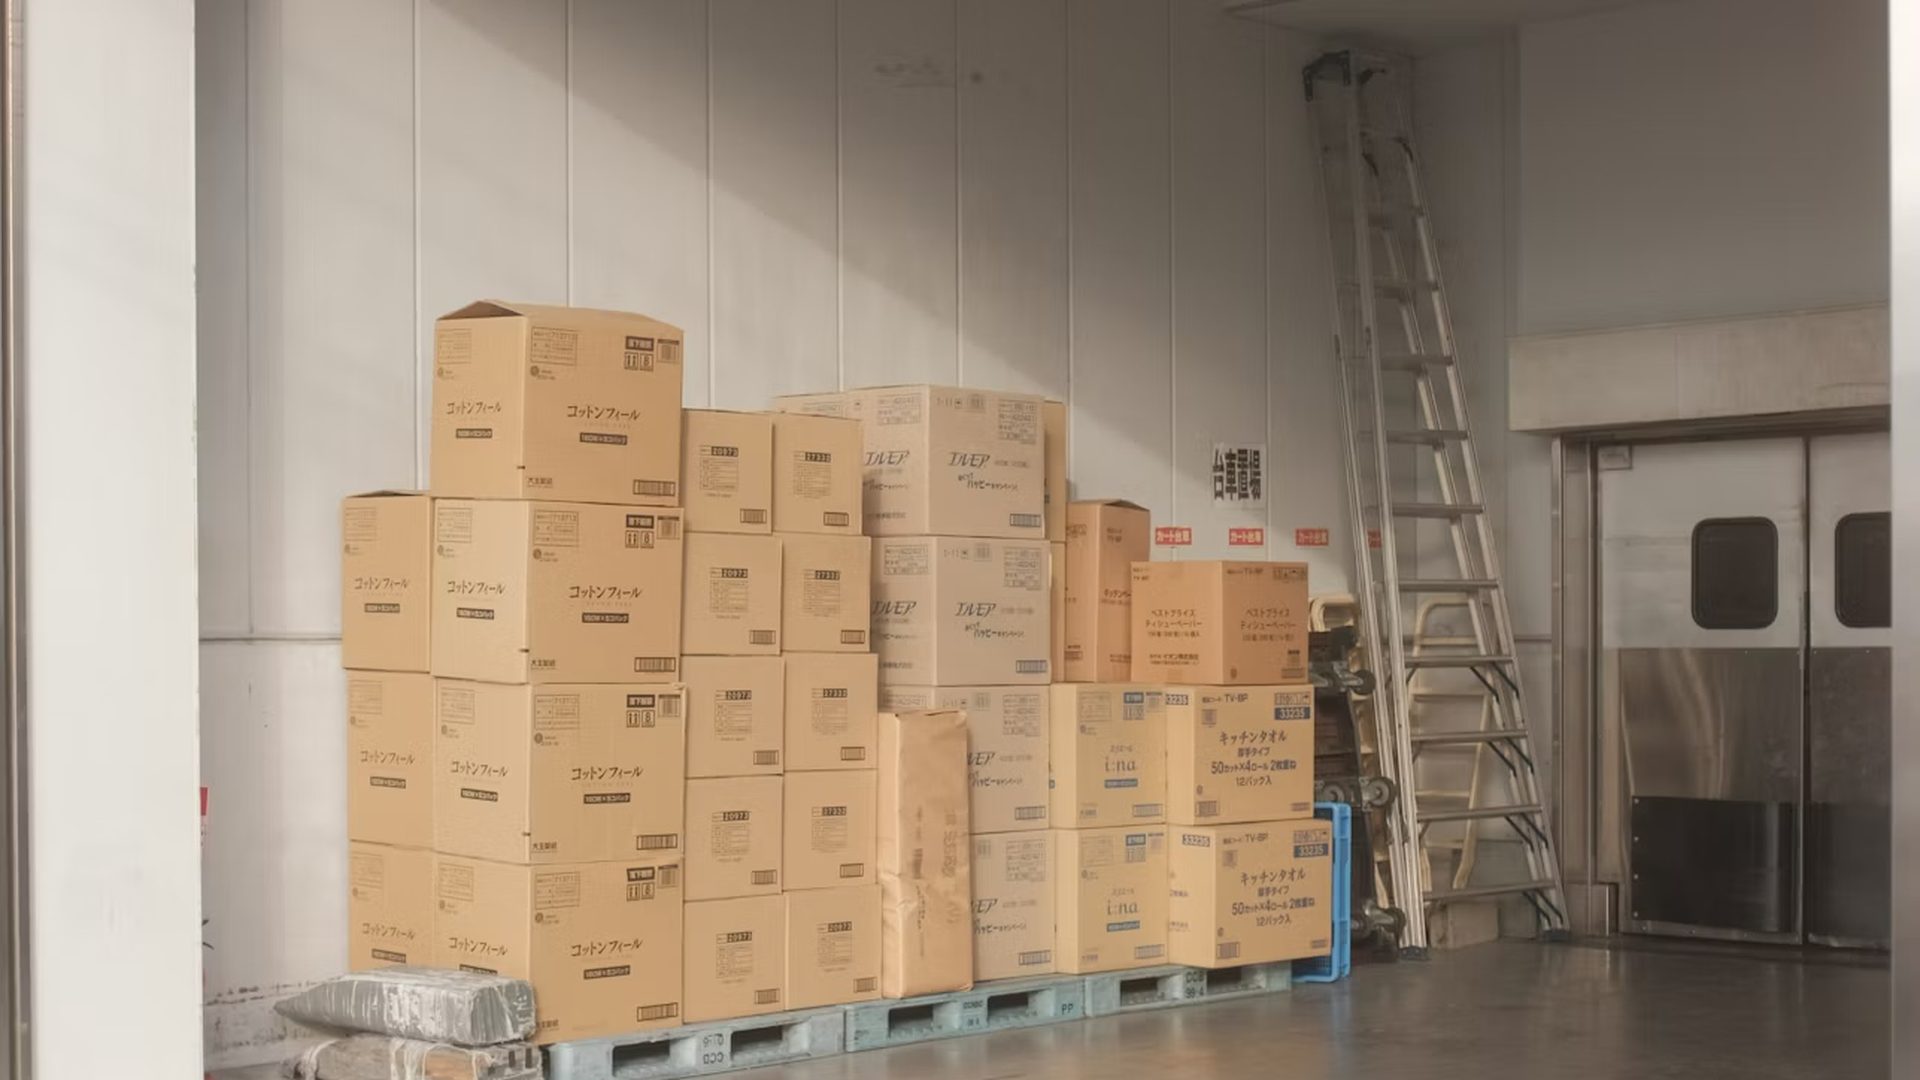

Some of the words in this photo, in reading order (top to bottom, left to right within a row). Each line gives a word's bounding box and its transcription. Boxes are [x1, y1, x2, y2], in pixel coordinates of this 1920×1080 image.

[447, 400, 501, 416] コットンフィール
[567, 405, 640, 422] コットンフィール
[865, 451, 910, 466] エルモア
[947, 452, 990, 469] エルモア
[355, 576, 409, 591] コットンフィール
[447, 579, 506, 596] コットンフィール
[569, 585, 642, 600] コットンフィール
[954, 602, 997, 618] エルモア
[1151, 609, 1195, 618] ベストプライス
[1246, 608, 1290, 618] ベストプライス
[1280, 708, 1305, 719] 33235
[1219, 729, 1287, 745] キッチンタオル
[360, 750, 416, 766] コットンフィール
[451, 760, 508, 777] コットンフィール
[571, 766, 643, 781] コットンフィール
[1235, 776, 1272, 786] 12パック入
[1298, 845, 1324, 857] 33235
[1240, 867, 1306, 886] キッチンタオル
[1256, 914, 1292, 927] 12パック入
[449, 937, 507, 957] コットンフィール
[570, 938, 643, 957] コットンフィール
